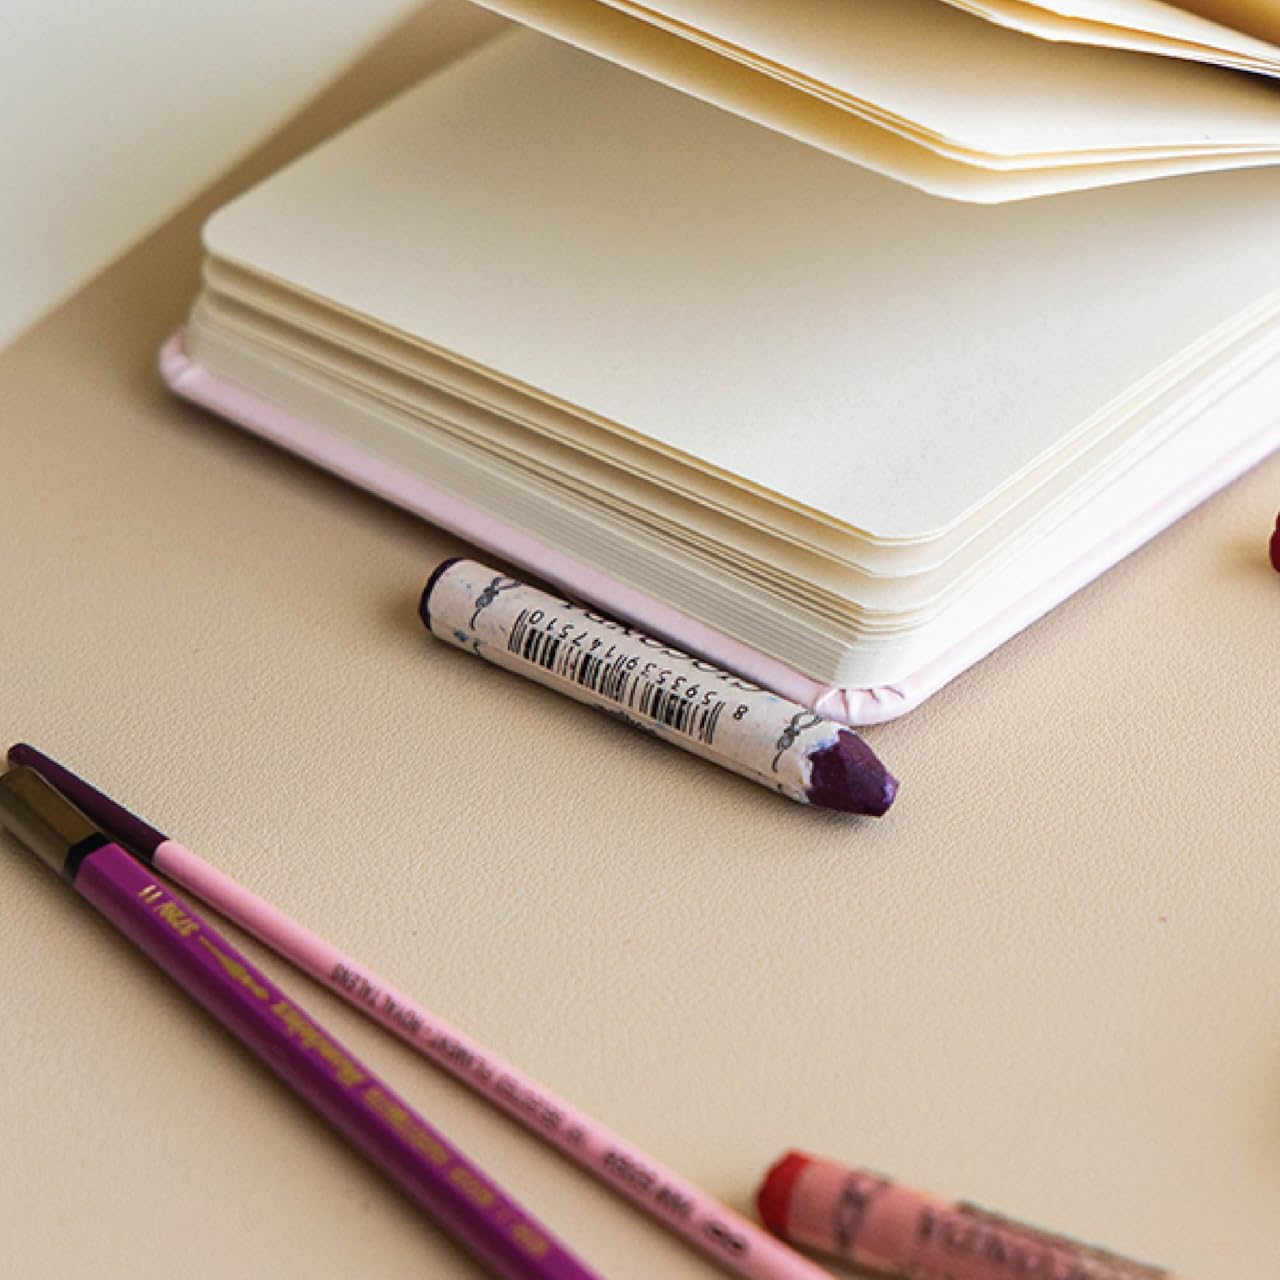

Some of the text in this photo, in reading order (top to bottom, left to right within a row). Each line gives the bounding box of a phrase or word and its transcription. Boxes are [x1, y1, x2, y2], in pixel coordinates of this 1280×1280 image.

[528, 608, 617, 658] 147510
[626, 656, 718, 706] 593539
[732, 703, 749, 721] 8
